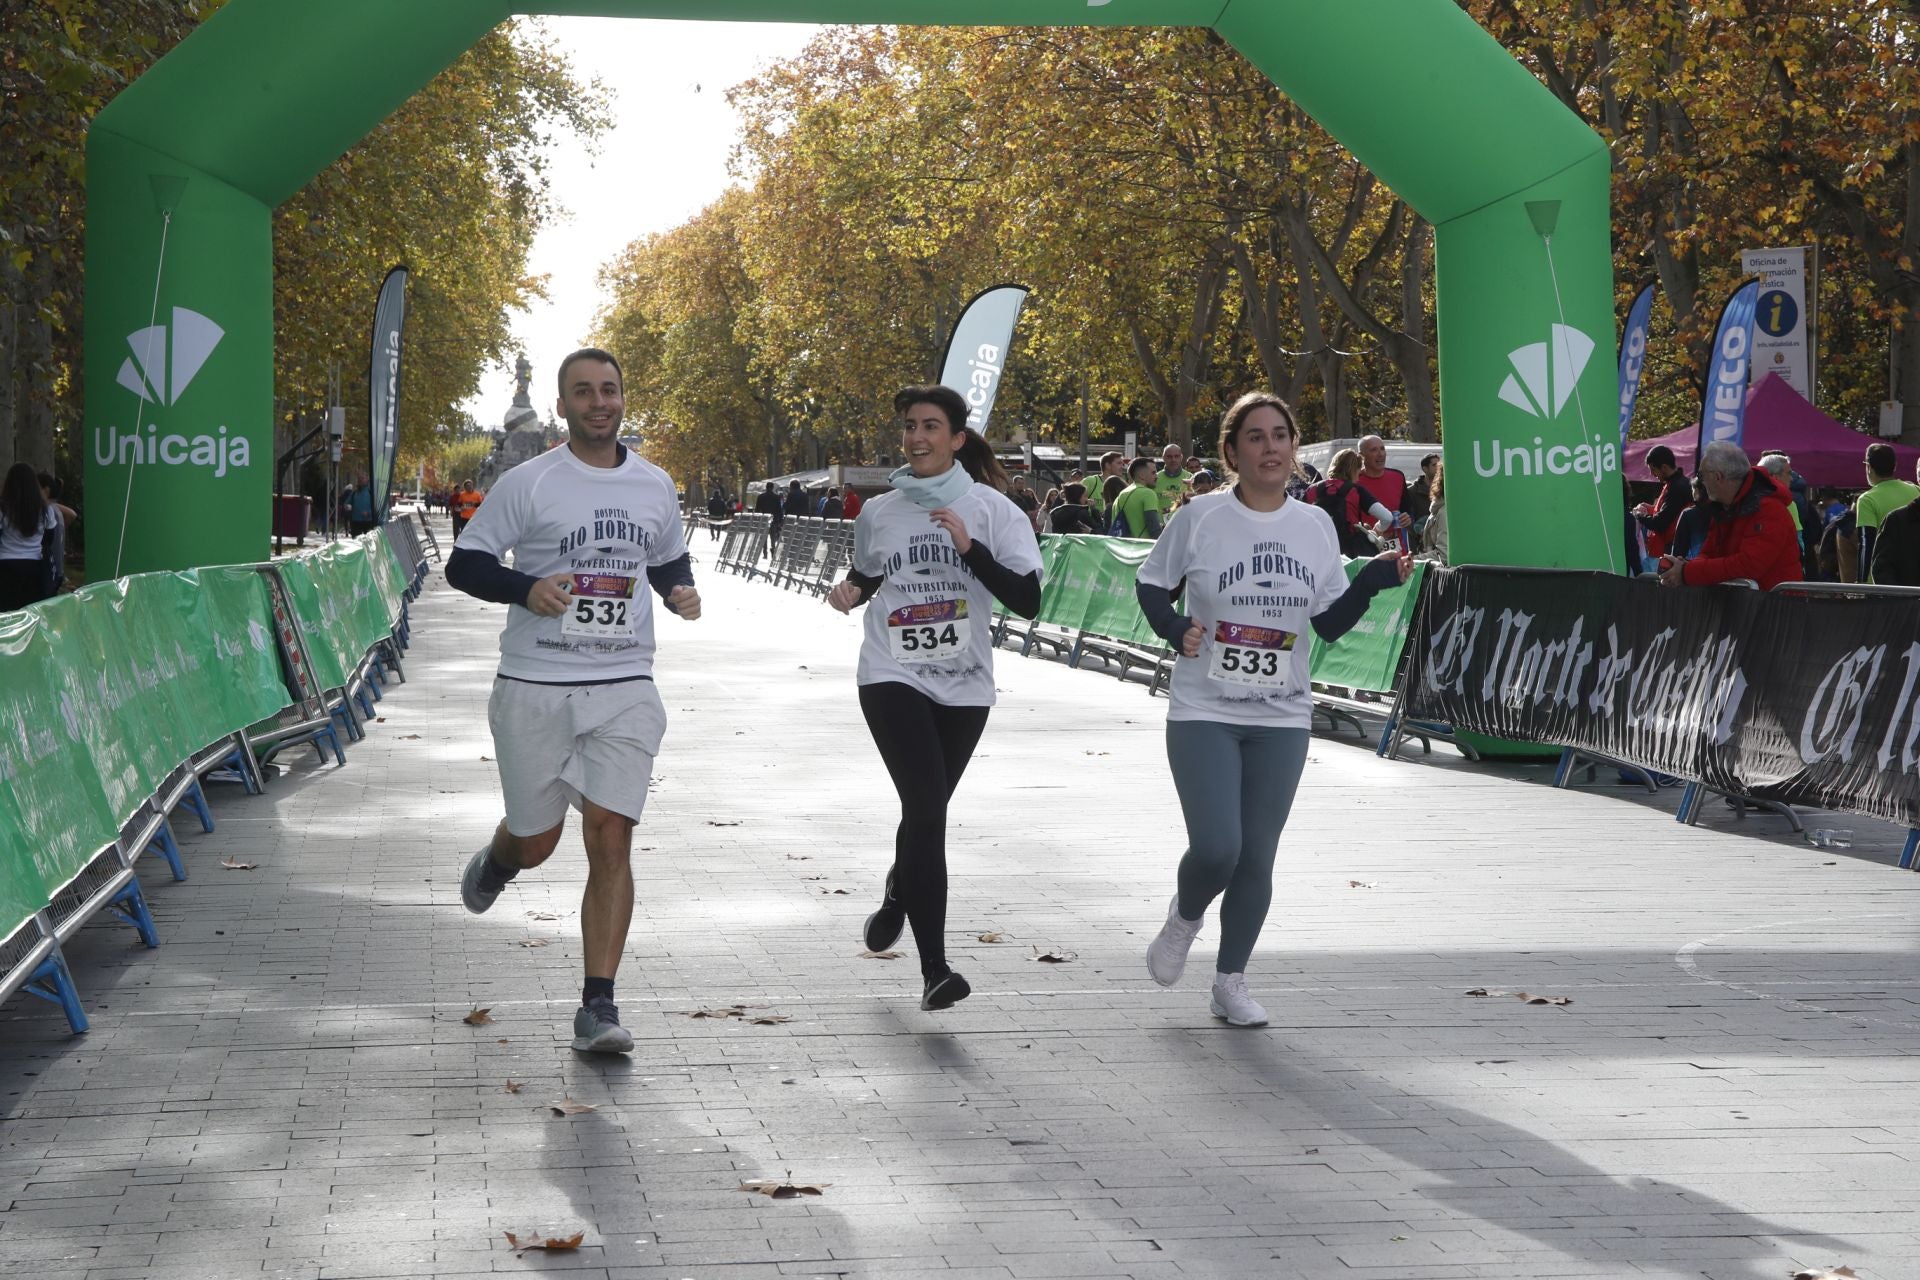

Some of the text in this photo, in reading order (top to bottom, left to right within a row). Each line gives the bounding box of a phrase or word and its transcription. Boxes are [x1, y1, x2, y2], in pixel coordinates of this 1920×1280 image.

[1750, 257, 1788, 267] Oficina de
[966, 343, 1000, 424] icaja
[1714, 326, 1746, 441] VECO
[95, 424, 250, 478] Unicaja
[1473, 433, 1617, 485] Unicaja
[594, 508, 630, 520] HOSPITAL
[559, 520, 654, 556] RIO HORTEG
[910, 533, 944, 544] HOSPITAL
[1253, 541, 1287, 554] HOSPITAL
[1218, 553, 1316, 595] RIO HORTEGA
[575, 599, 626, 626] 532
[924, 595, 945, 603] 1953
[1232, 595, 1309, 607] UNIVERSITARIO
[1261, 609, 1283, 618] 1953
[902, 623, 959, 651] 534
[1221, 647, 1278, 676] 533
[1426, 605, 1485, 696] El
[1482, 608, 1594, 711] Norte
[1588, 622, 1634, 719] de
[1800, 643, 1887, 766] El
